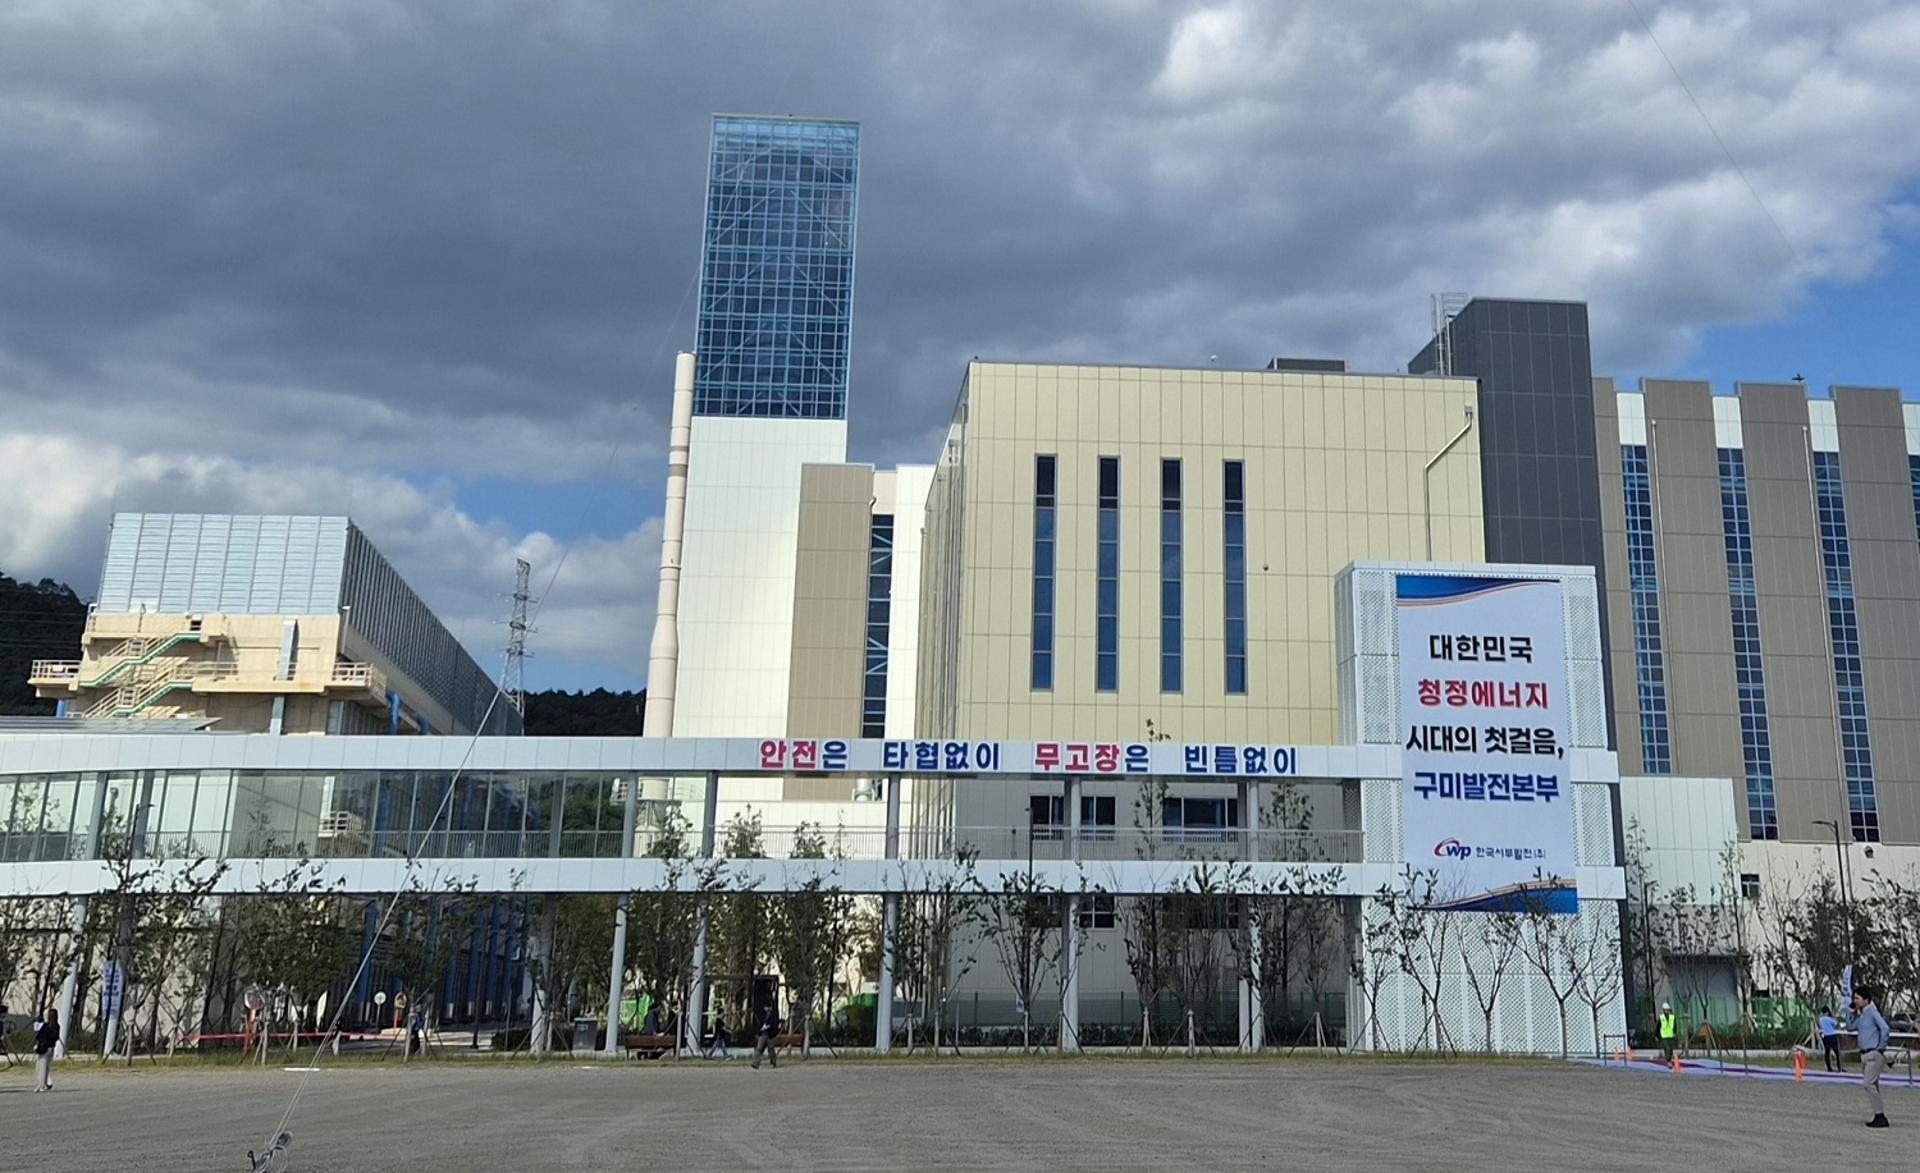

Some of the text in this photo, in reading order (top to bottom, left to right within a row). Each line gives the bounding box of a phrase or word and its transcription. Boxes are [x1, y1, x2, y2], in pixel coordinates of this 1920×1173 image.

[1429, 634, 1533, 663] 대한민국
[1418, 679, 1549, 709] 청정에너지
[760, 740, 1296, 774] 안전은 타협없이 무고장은 빈틈없이
[1406, 725, 1564, 759] 시대의 첫걸음,
[1413, 771, 1560, 802] 구미발전본부
